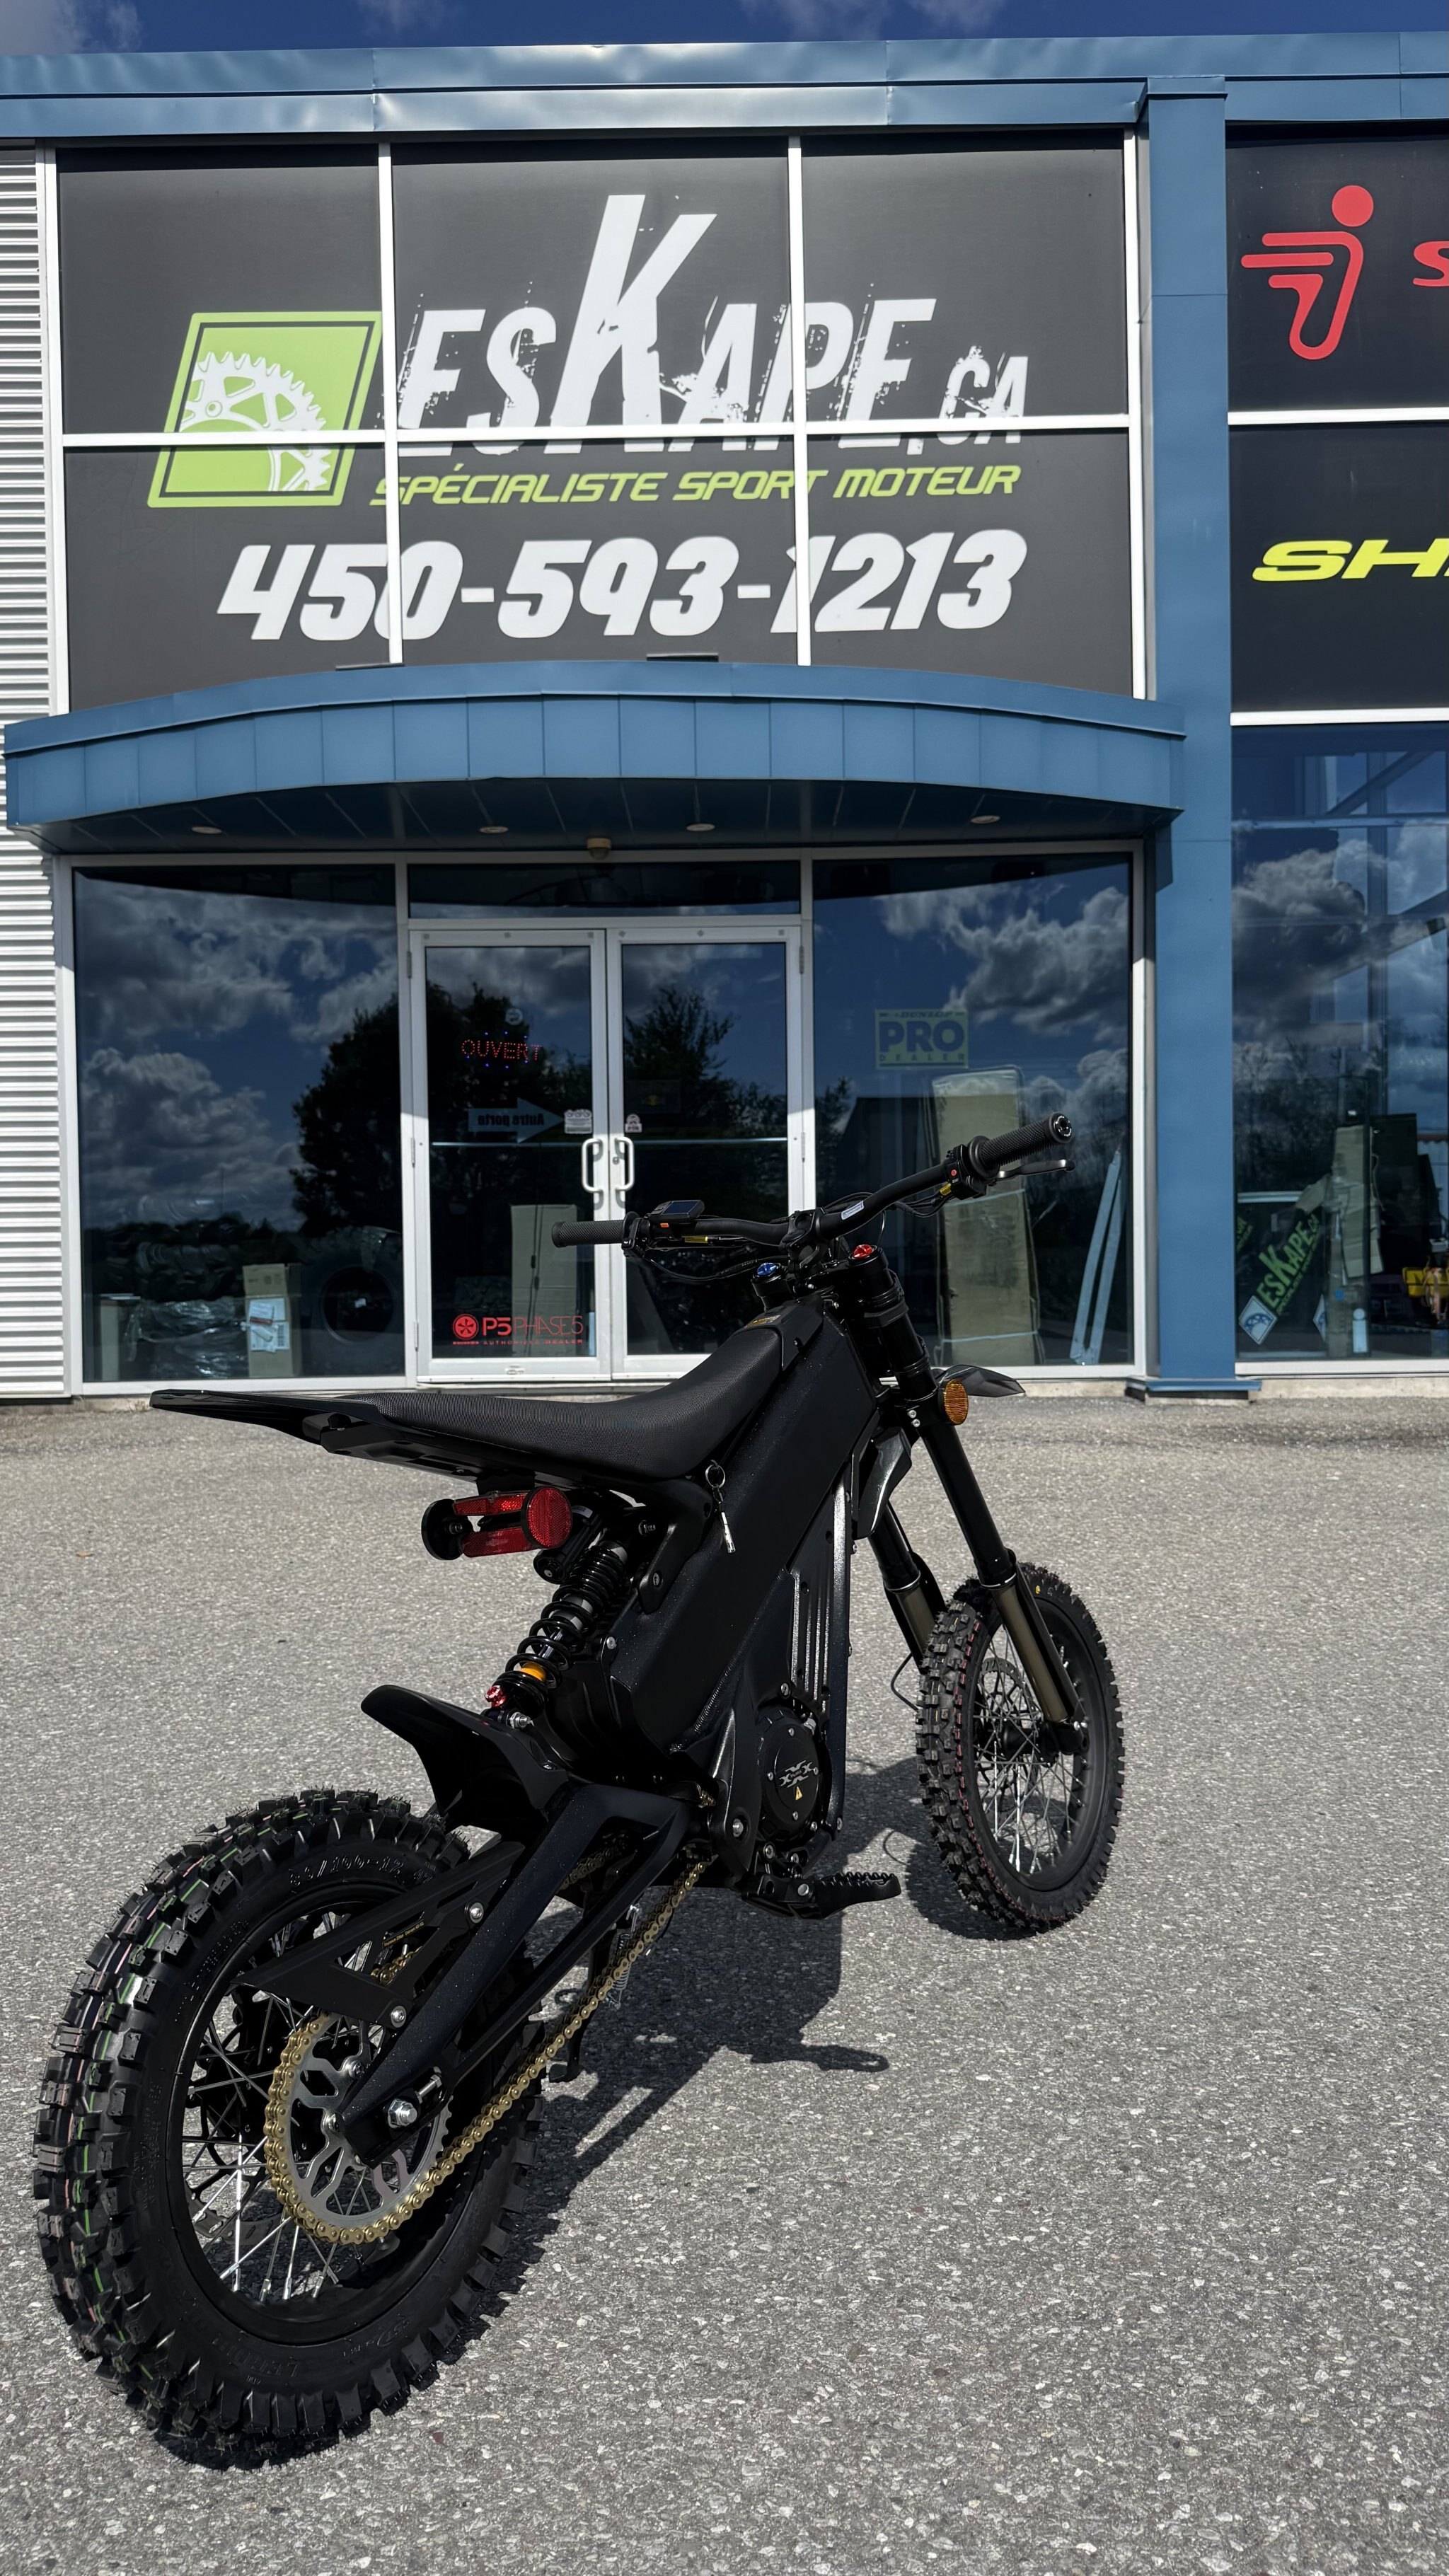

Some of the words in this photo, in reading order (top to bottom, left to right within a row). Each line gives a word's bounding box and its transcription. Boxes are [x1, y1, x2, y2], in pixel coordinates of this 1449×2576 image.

[369, 463, 669, 507] SPÉCIALISTE
[673, 470, 828, 502] SPORT
[833, 466, 1022, 498] MOTEUR
[1252, 538, 1449, 582] SH
[217, 529, 1028, 641] 450-593-1213
[461, 1039, 543, 1061] OUVERT
[879, 1020, 964, 1052] PRO
[879, 1053, 964, 1061] DEALER
[483, 1317, 512, 1336] P5
